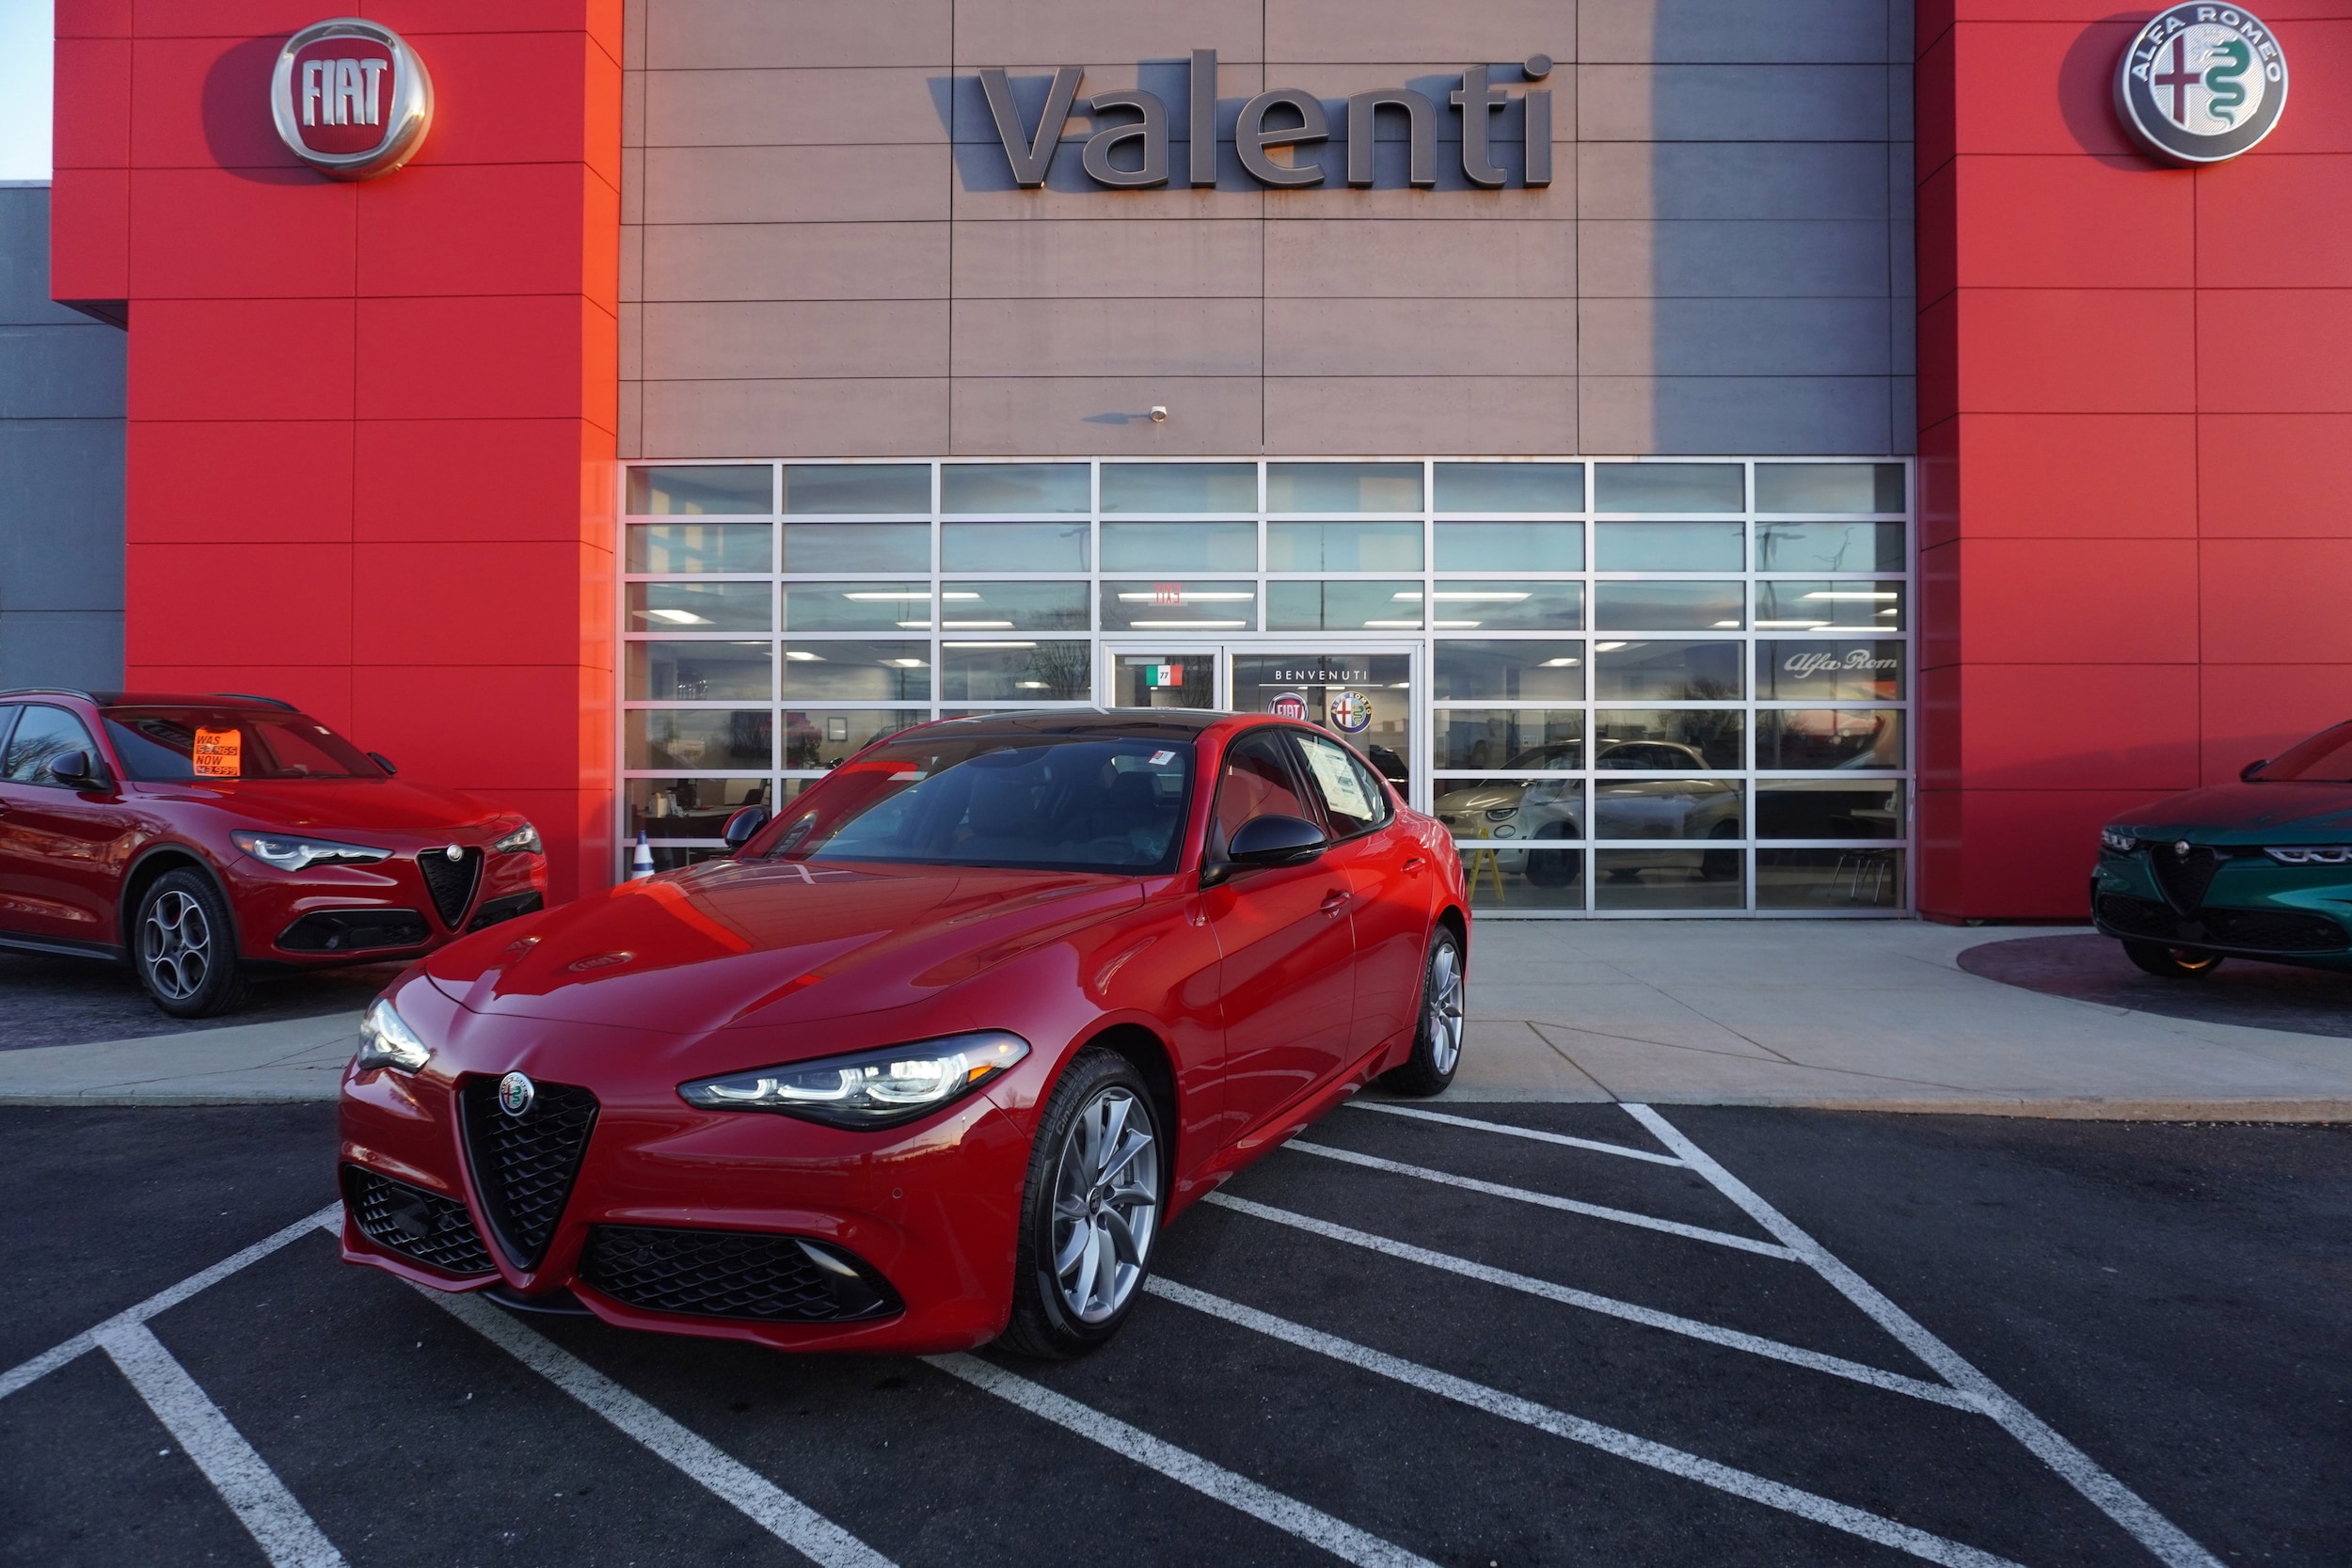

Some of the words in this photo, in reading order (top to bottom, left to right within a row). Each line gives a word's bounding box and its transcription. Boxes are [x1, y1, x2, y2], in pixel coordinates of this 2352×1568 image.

[2131, 16, 2185, 83] ALFA
[2197, 8, 2281, 83] ROMEO
[303, 58, 388, 126] FIAT
[977, 48, 1553, 188] Valenti
[1276, 671, 1367, 680] BENVENUTI
[1784, 653, 1841, 679] Alfa
[1277, 704, 1300, 719] FIAT
[197, 736, 221, 745] WAS
[196, 755, 223, 765] NOW
